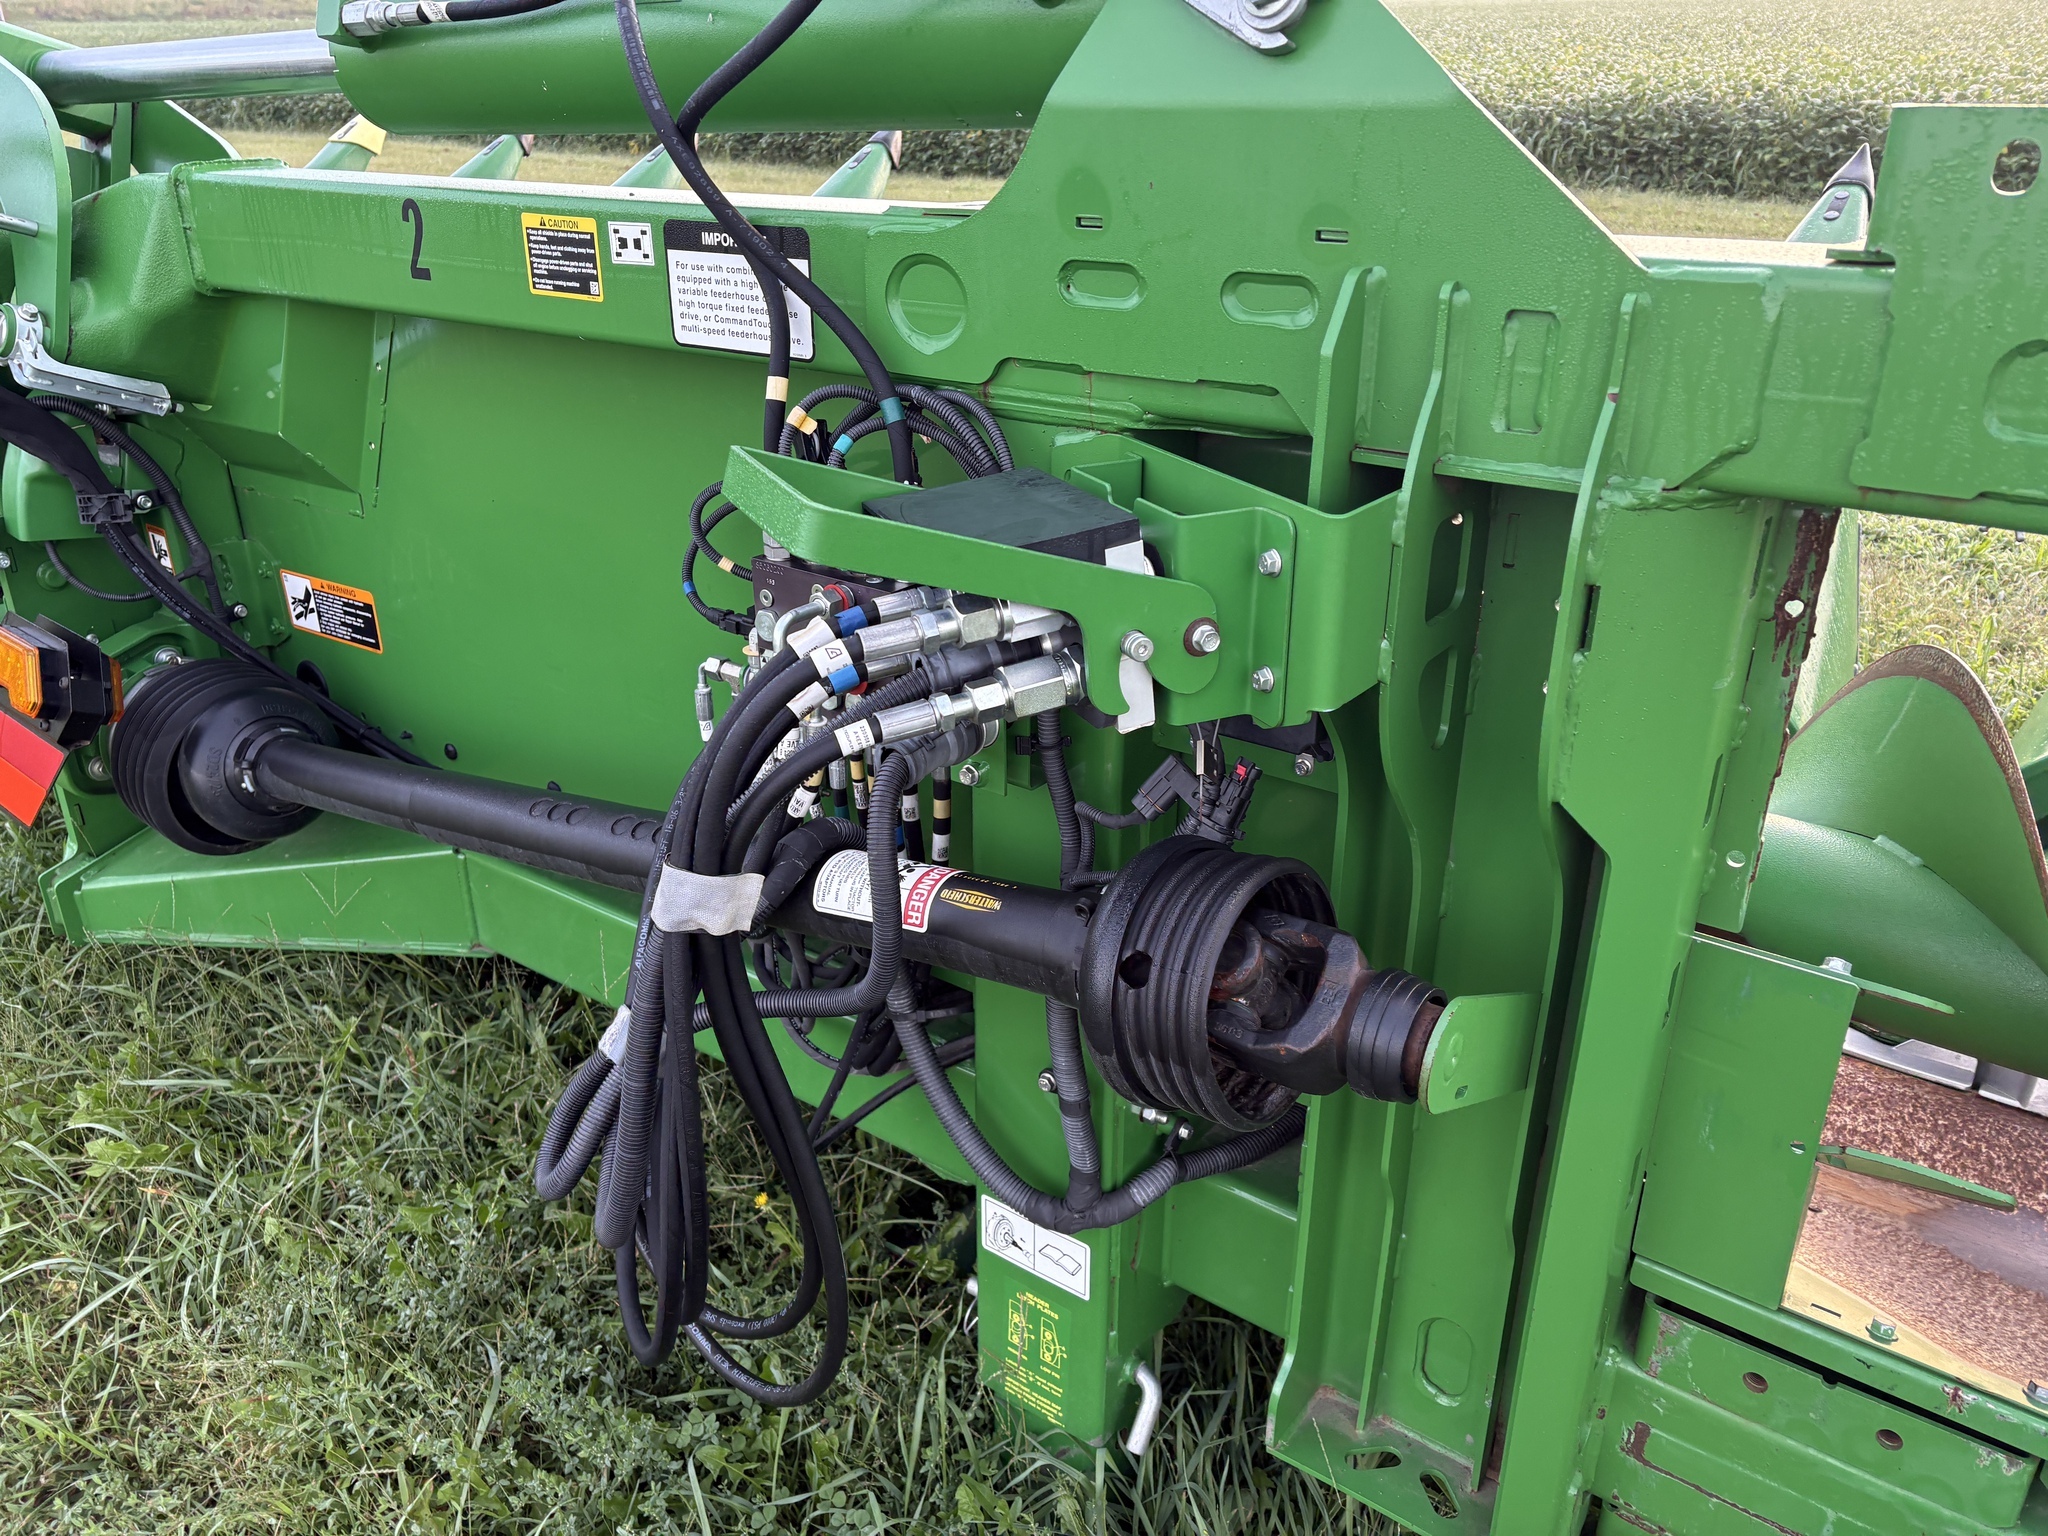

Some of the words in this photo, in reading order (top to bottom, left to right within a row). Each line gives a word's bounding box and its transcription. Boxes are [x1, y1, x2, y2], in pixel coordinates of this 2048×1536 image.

[548, 219, 578, 229] CAUTION
[402, 198, 431, 281] 2
[675, 261, 688, 269] For
[707, 264, 723, 273] with
[677, 275, 712, 285] equipped
[714, 277, 731, 286] with
[741, 281, 759, 290] high
[678, 288, 708, 297] variable
[710, 290, 759, 302] feederhouse
[678, 298, 696, 310] high
[698, 302, 723, 312] torque
[725, 302, 745, 313] fixed
[680, 311, 702, 322] drive,
[681, 324, 726, 336] multi-speed
[326, 584, 356, 597] WARNING
[907, 867, 948, 926] DANGER
[940, 889, 1002, 911] WALTERSCHEID
[720, 1318, 745, 1328] exceeds
